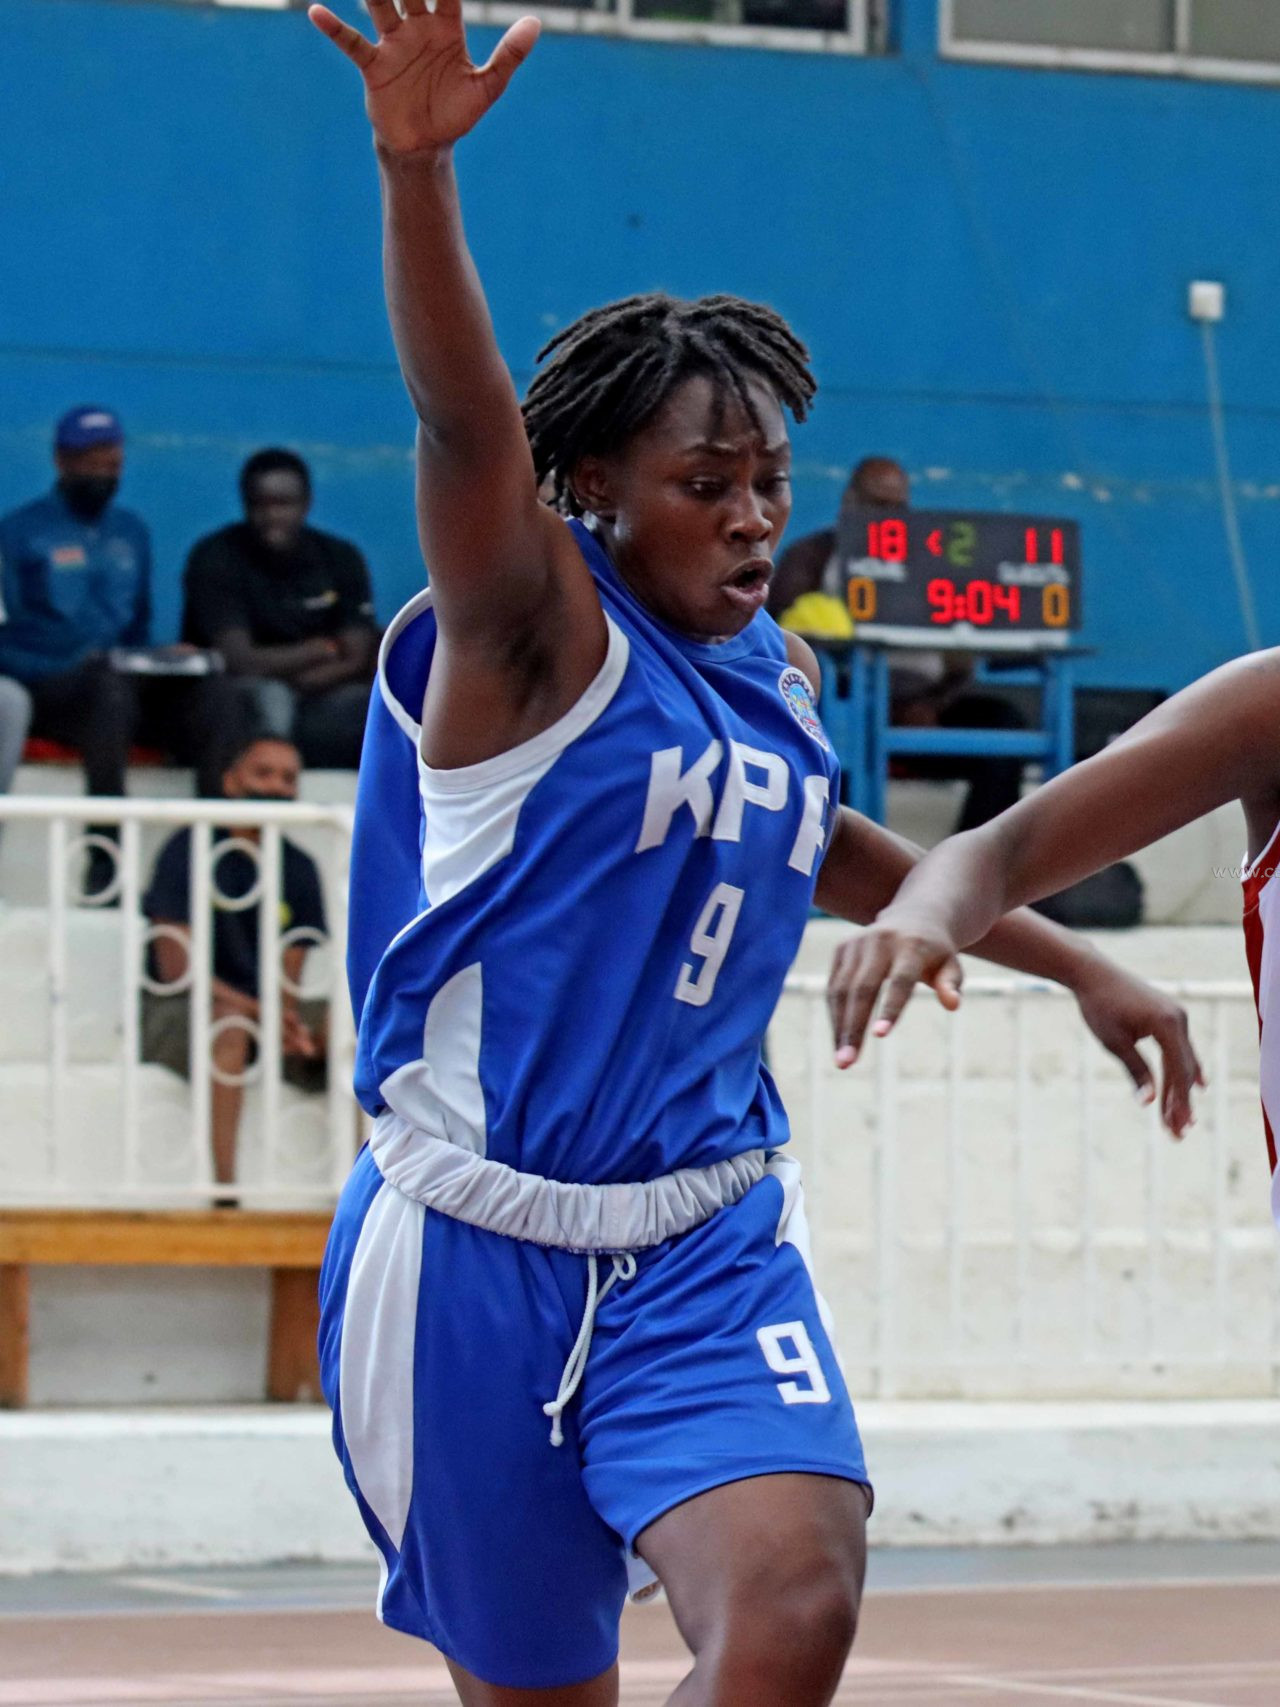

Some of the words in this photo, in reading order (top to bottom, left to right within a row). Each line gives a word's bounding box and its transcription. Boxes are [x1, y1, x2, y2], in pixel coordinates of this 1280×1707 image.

[867, 519, 907, 562] 18
[948, 521, 976, 567] 2
[1025, 528, 1063, 565] 11
[848, 577, 876, 621] 0
[926, 578, 1020, 624] 9:04
[1042, 583, 1069, 627] 0
[673, 882, 745, 1007] 9
[757, 1320, 831, 1404] 9
